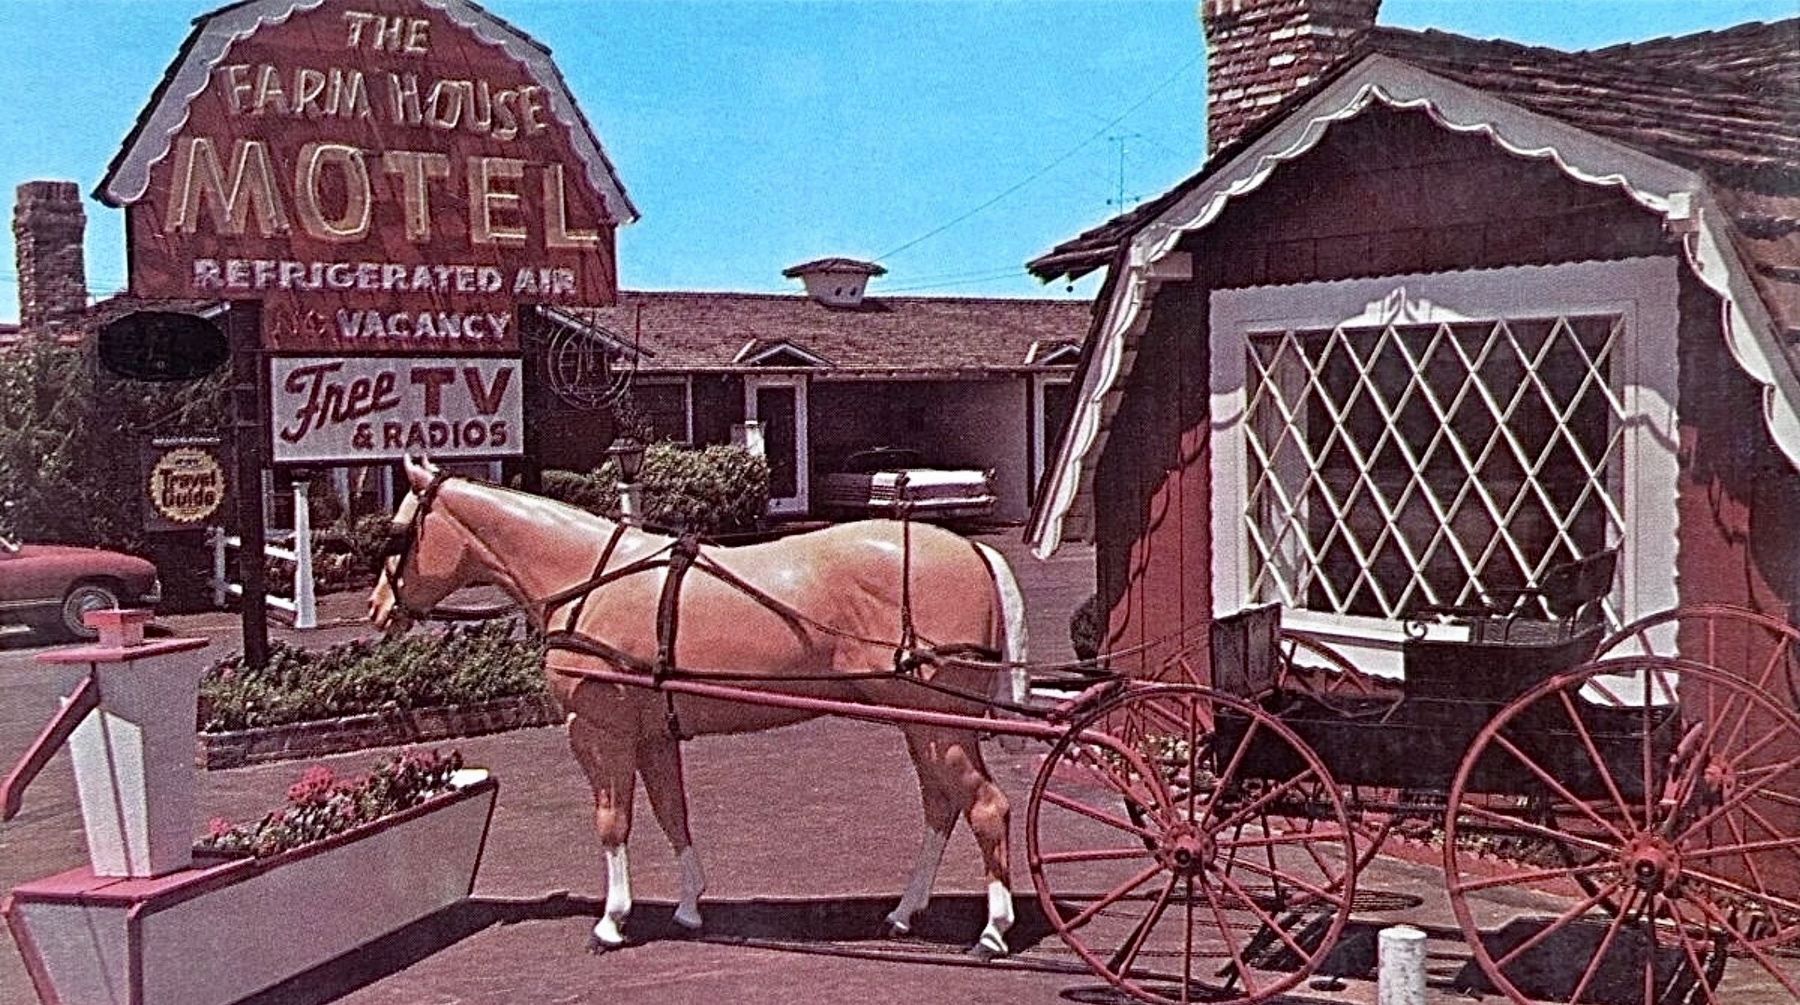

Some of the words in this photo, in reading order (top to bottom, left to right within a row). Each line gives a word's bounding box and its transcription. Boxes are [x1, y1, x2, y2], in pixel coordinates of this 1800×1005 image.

[345, 11, 430, 52] THE
[220, 64, 373, 118] FARM
[387, 71, 549, 141] HOUSE
[164, 137, 600, 248] MOTEL
[193, 258, 502, 292] REFRIGERATED
[512, 266, 577, 295] AIR
[336, 307, 511, 339] VACANCY
[280, 361, 402, 444] Free
[410, 366, 515, 417] TV
[352, 423, 374, 450] &
[383, 420, 507, 449] RADIOS
